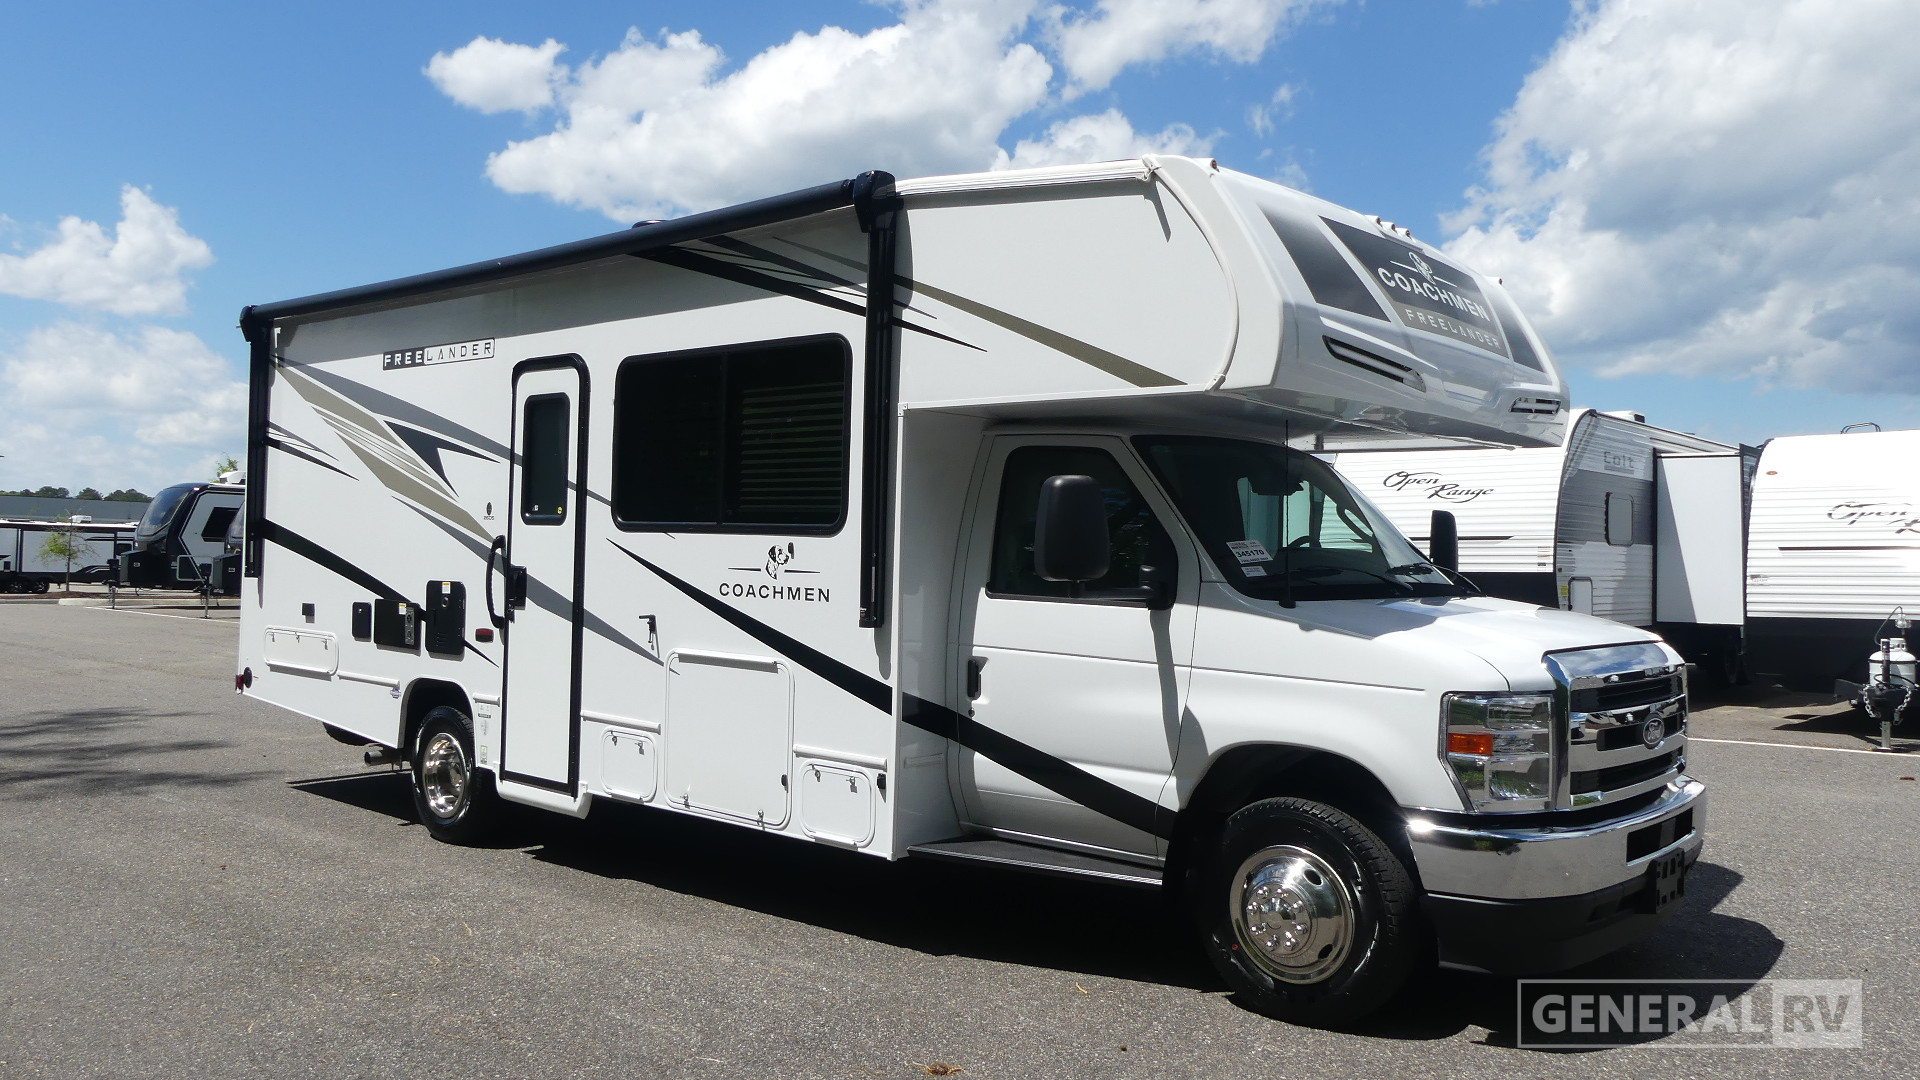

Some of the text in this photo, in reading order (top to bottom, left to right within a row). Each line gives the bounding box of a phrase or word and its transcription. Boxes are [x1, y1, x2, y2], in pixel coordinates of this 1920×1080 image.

[1377, 267, 1490, 321] COACHMEN
[1404, 308, 1501, 350] FREELANDER
[384, 342, 492, 367] FREELANDER
[1603, 451, 1635, 469] Colt
[1383, 471, 1443, 492] Open
[1423, 483, 1495, 504] Range
[1235, 549, 1265, 558] 345170
[719, 582, 830, 603] COACHMEN
